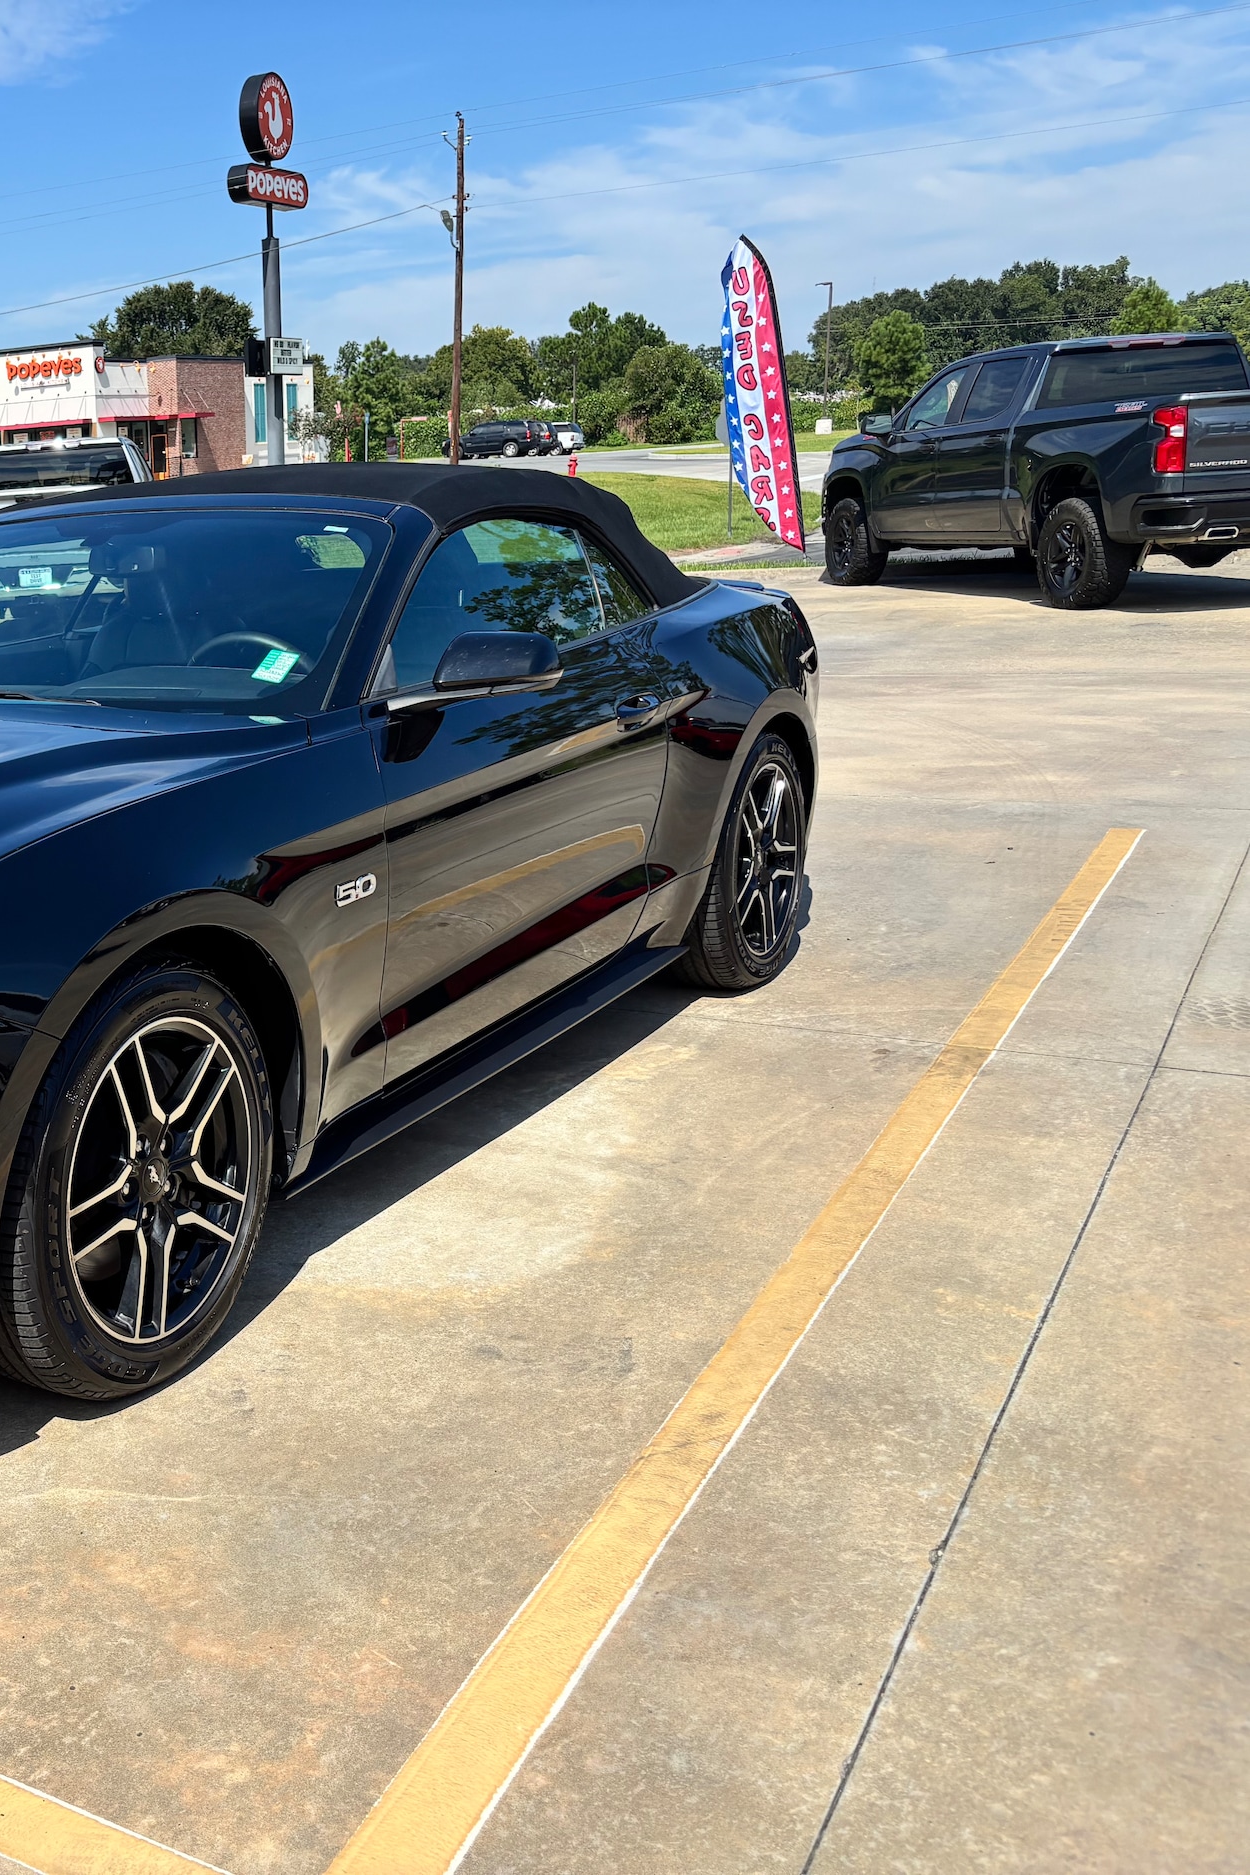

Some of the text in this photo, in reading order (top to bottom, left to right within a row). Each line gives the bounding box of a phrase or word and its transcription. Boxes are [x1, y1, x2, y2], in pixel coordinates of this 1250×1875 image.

[259, 76, 288, 104] LOUISIANA
[263, 134, 288, 156] KITCHEN
[227, 1008, 271, 1116] KELLY
[48, 1167, 78, 1324] SPORT
